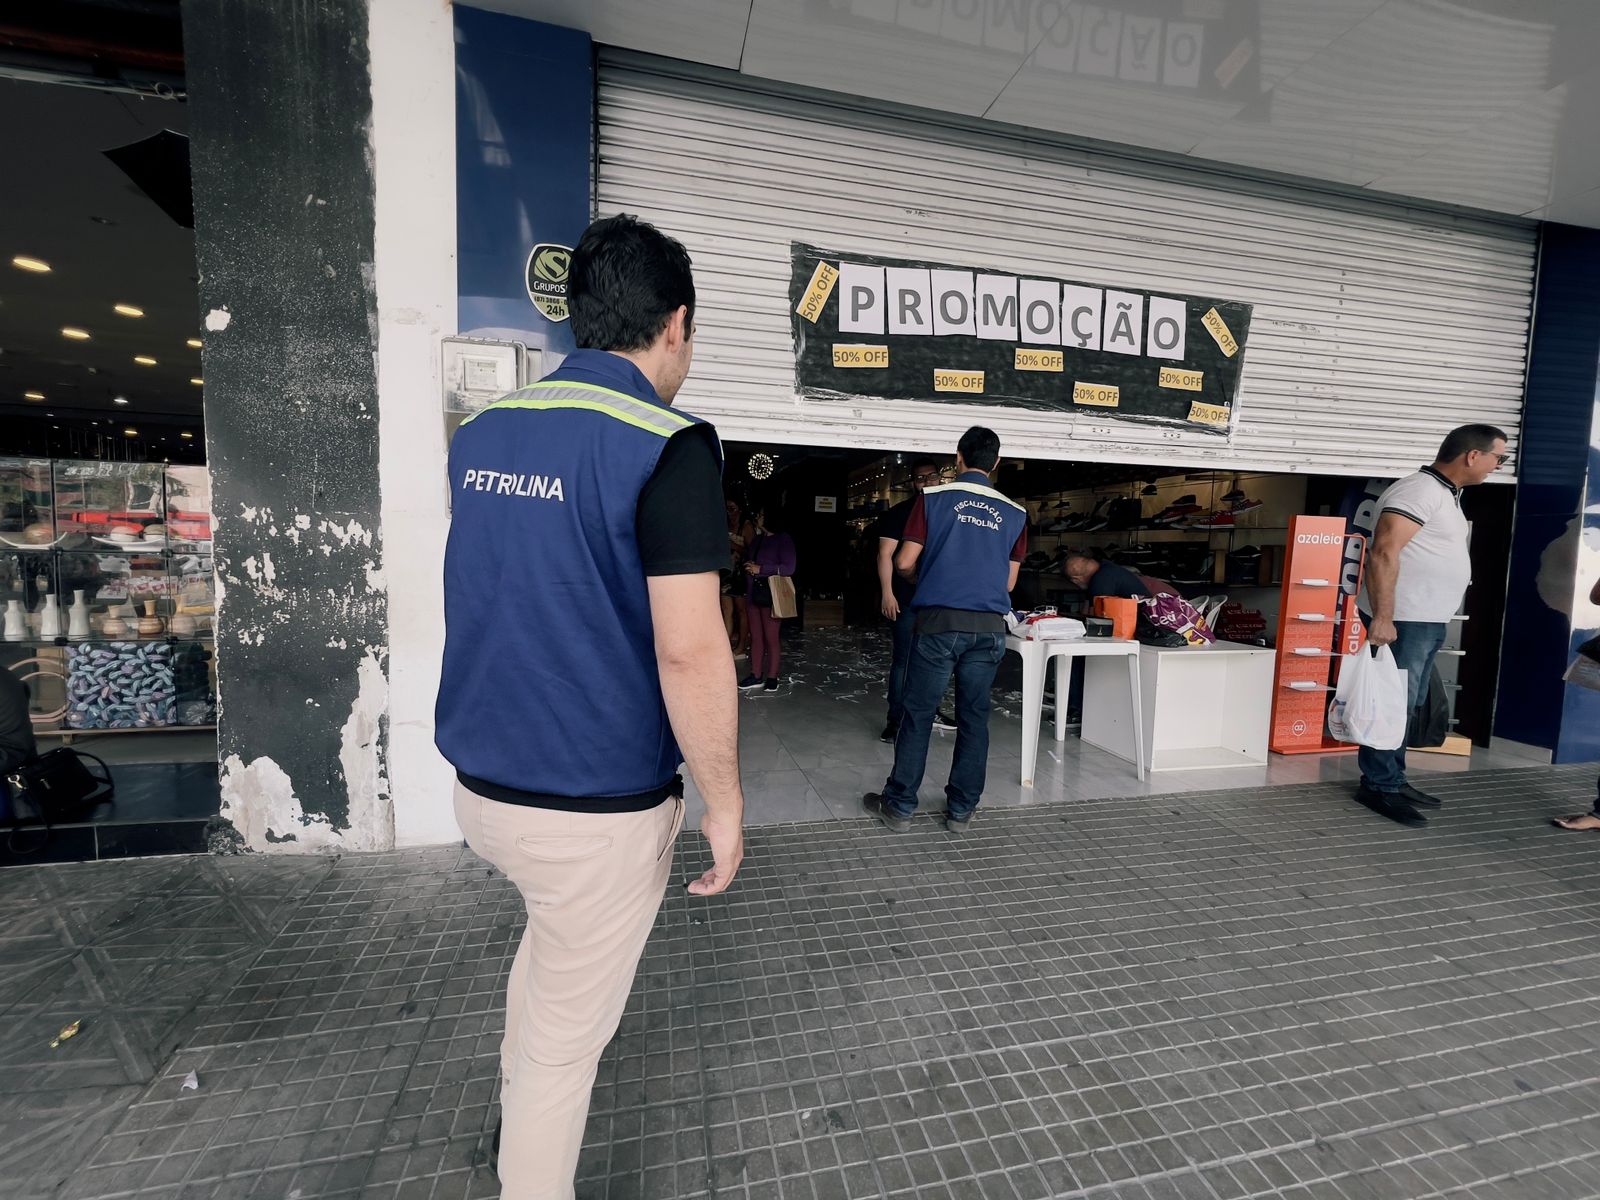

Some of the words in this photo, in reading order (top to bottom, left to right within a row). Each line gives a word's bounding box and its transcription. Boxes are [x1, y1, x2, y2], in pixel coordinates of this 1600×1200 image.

[533, 281, 568, 294] GRUPOS
[803, 292, 823, 319] 50%
[816, 265, 834, 291] OFF
[546, 304, 565, 316] 24h
[851, 285, 1181, 350] PROMOÇÃO
[1205, 311, 1222, 335] 50%
[1220, 334, 1236, 352] OFF
[834, 351, 860, 362] 50%
[863, 351, 887, 363] OFF
[1016, 354, 1038, 366] 50%
[1041, 355, 1062, 367] OFF
[935, 375, 959, 387] 50%
[961, 377, 983, 389] OFF
[1159, 372, 1180, 385] 50%
[1183, 375, 1201, 387] OFF
[1074, 388, 1095, 401] 50%
[1097, 390, 1118, 402] OFF
[1190, 406, 1209, 419] 50%
[1210, 410, 1229, 422] OFF
[953, 500, 1003, 524] FISCALIZAÇÃO
[957, 513, 999, 531] PETROLINA
[1297, 531, 1342, 545] azaleia
